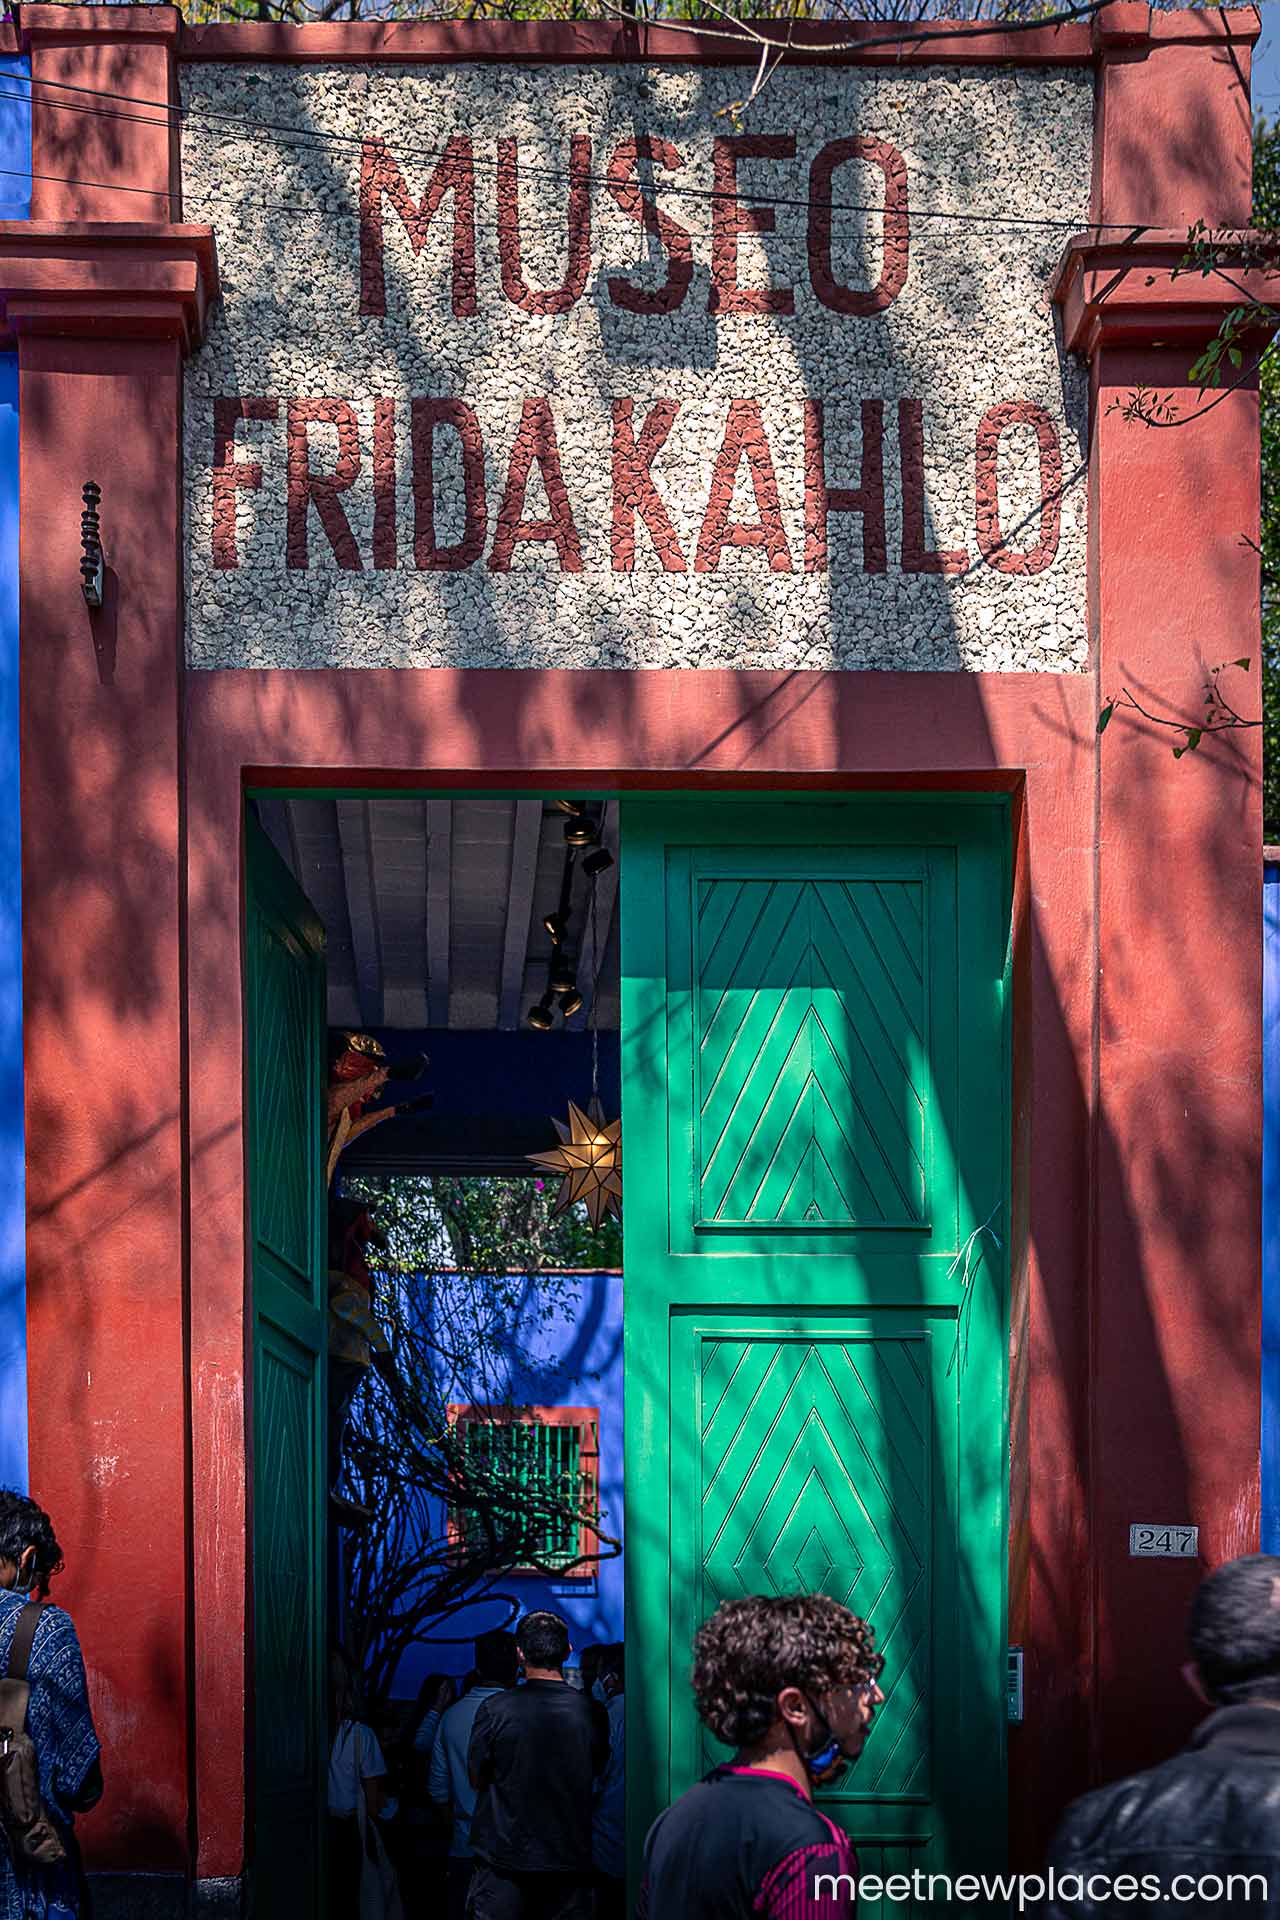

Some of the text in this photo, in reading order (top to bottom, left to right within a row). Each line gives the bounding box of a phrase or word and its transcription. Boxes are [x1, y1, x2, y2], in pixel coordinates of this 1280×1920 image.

[358, 134, 909, 317] MUSEO
[212, 398, 1061, 575] FRIDA KAHLO
[1139, 1530, 1192, 1552] 247
